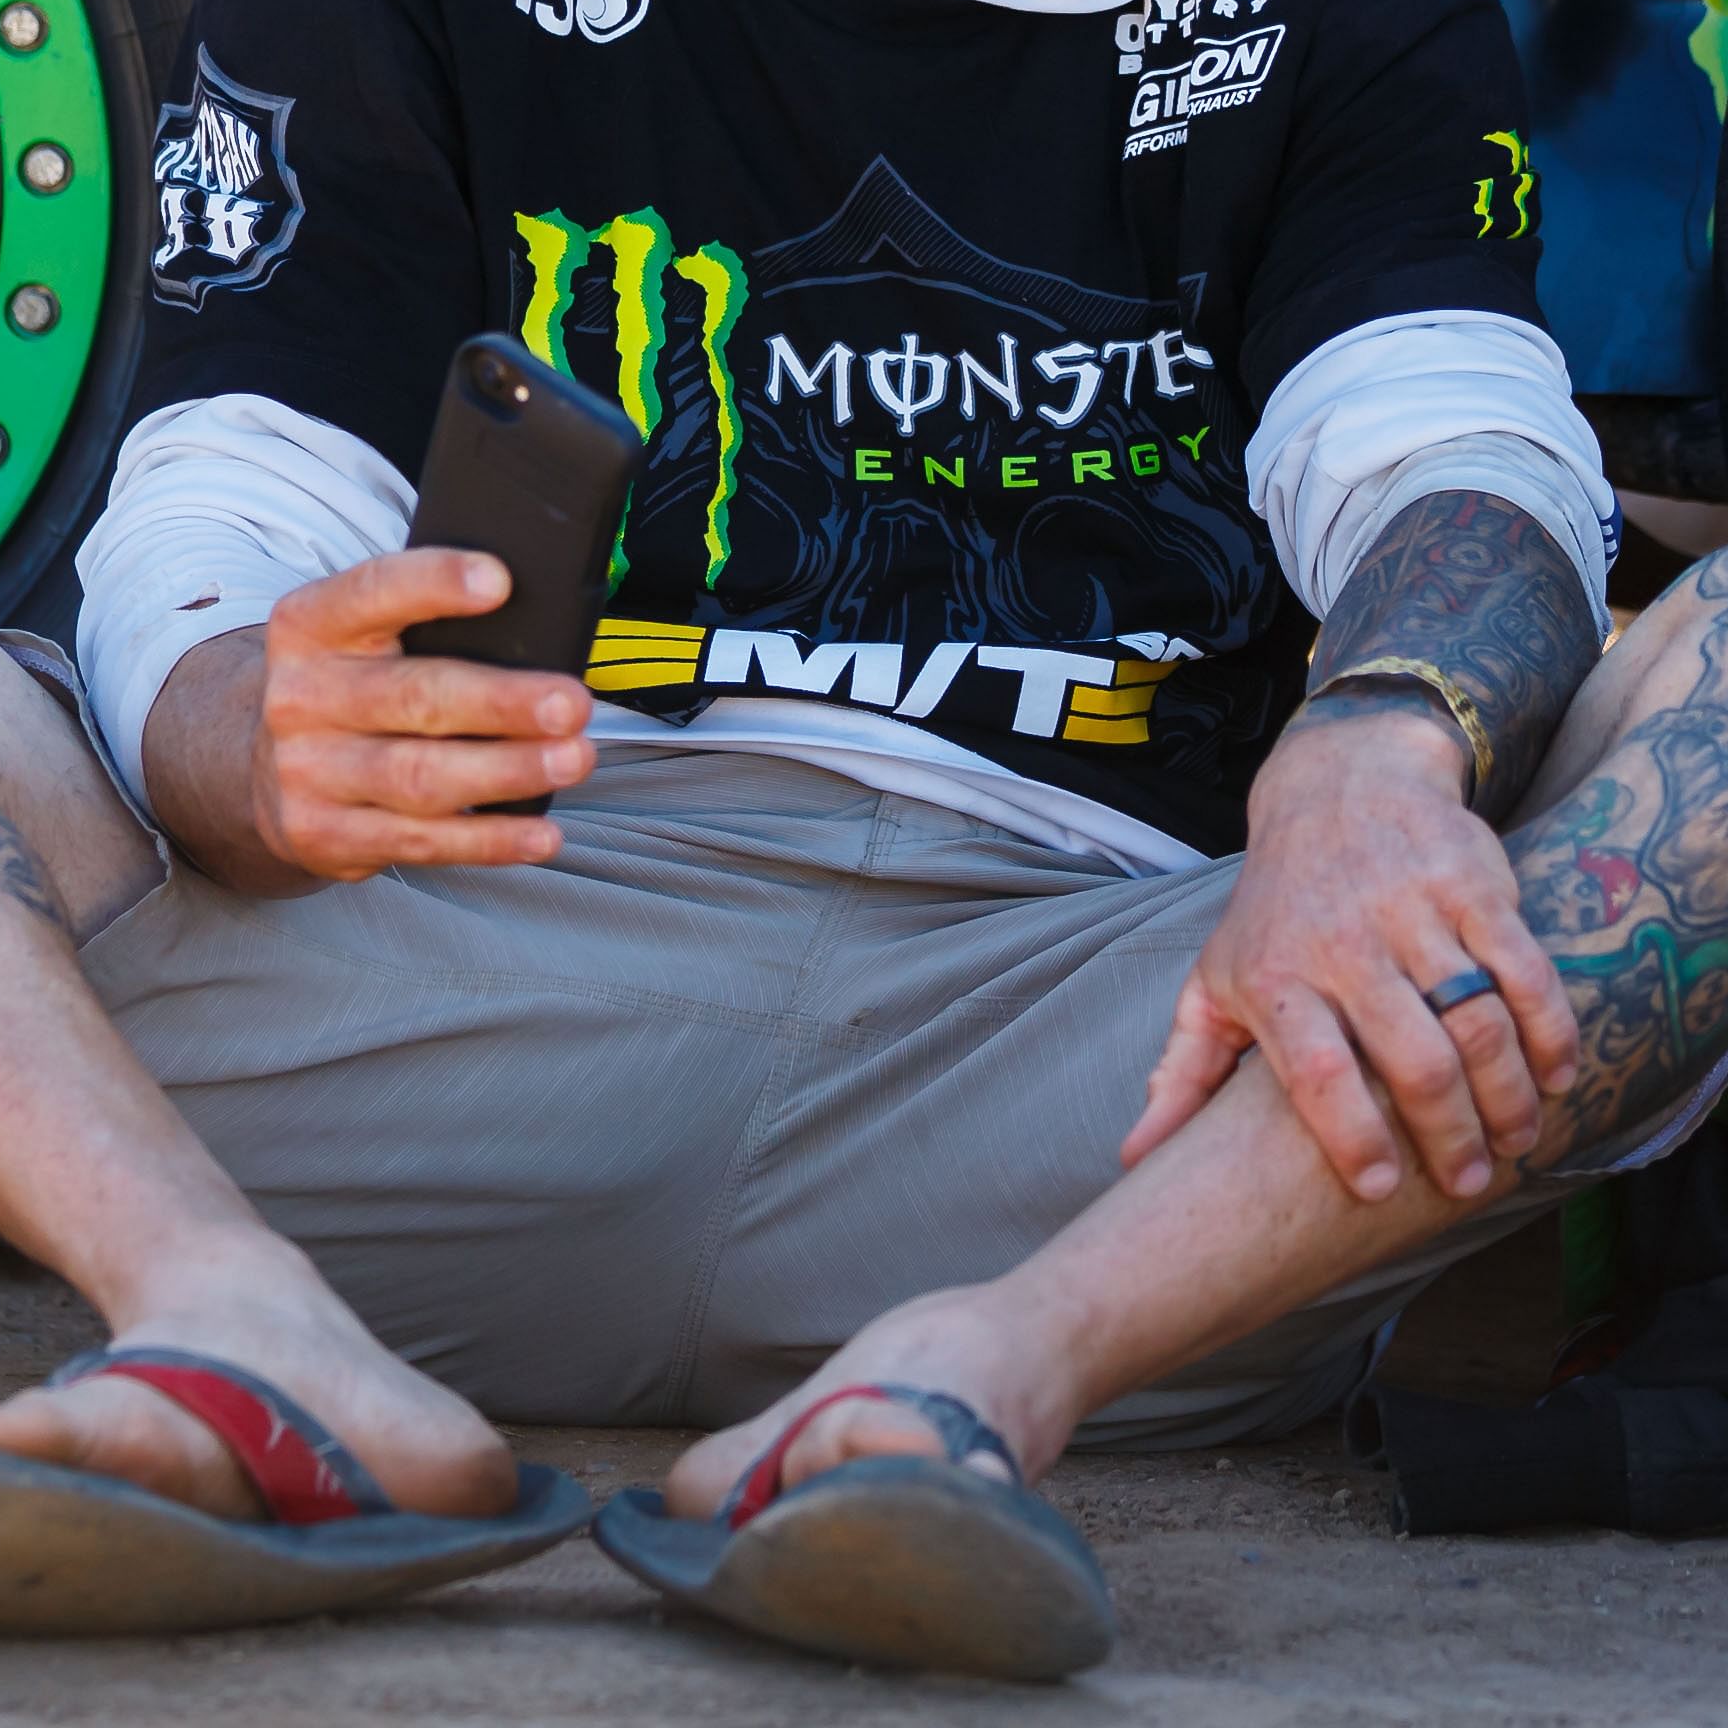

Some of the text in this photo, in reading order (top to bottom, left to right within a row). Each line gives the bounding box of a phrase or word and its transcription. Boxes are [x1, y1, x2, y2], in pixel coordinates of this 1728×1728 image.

[1188, 87, 1262, 120] XHAUST
[764, 329, 1214, 437] MONSTE
[855, 426, 1213, 489] ENERGY
[703, 628, 1115, 739] M/T
